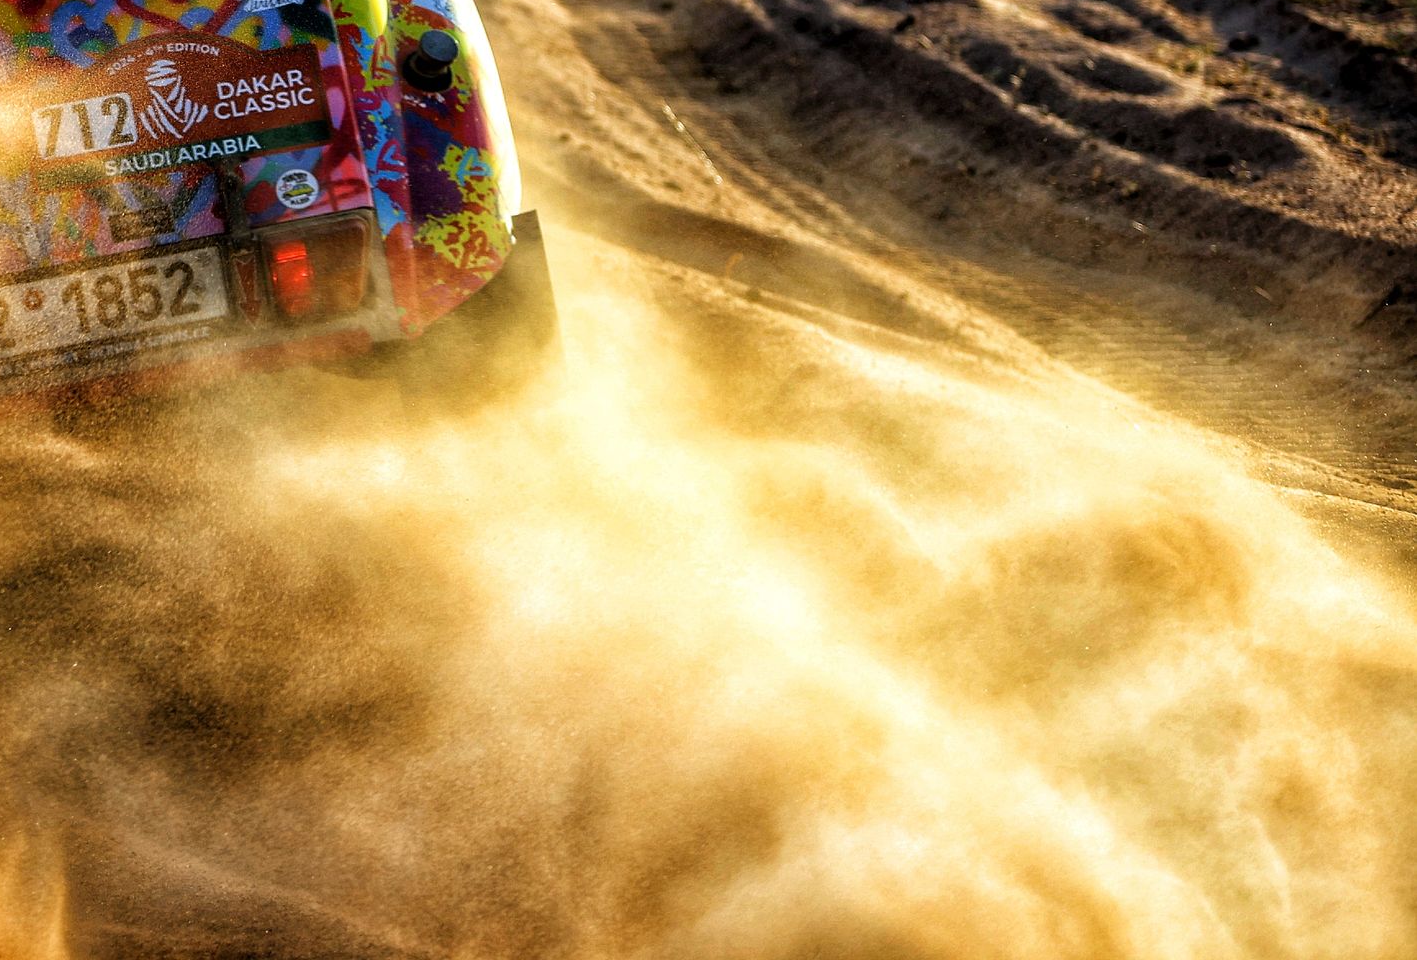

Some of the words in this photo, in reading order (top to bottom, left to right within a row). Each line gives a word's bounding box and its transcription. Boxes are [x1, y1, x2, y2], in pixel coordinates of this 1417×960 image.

[166, 43, 221, 57] EDITION
[216, 69, 304, 100] DAKAR
[214, 87, 315, 120] CLASSIC
[39, 96, 134, 158] 712
[104, 151, 177, 177] SAUDI
[179, 135, 262, 163] ARABIA
[62, 260, 201, 333] 1852
